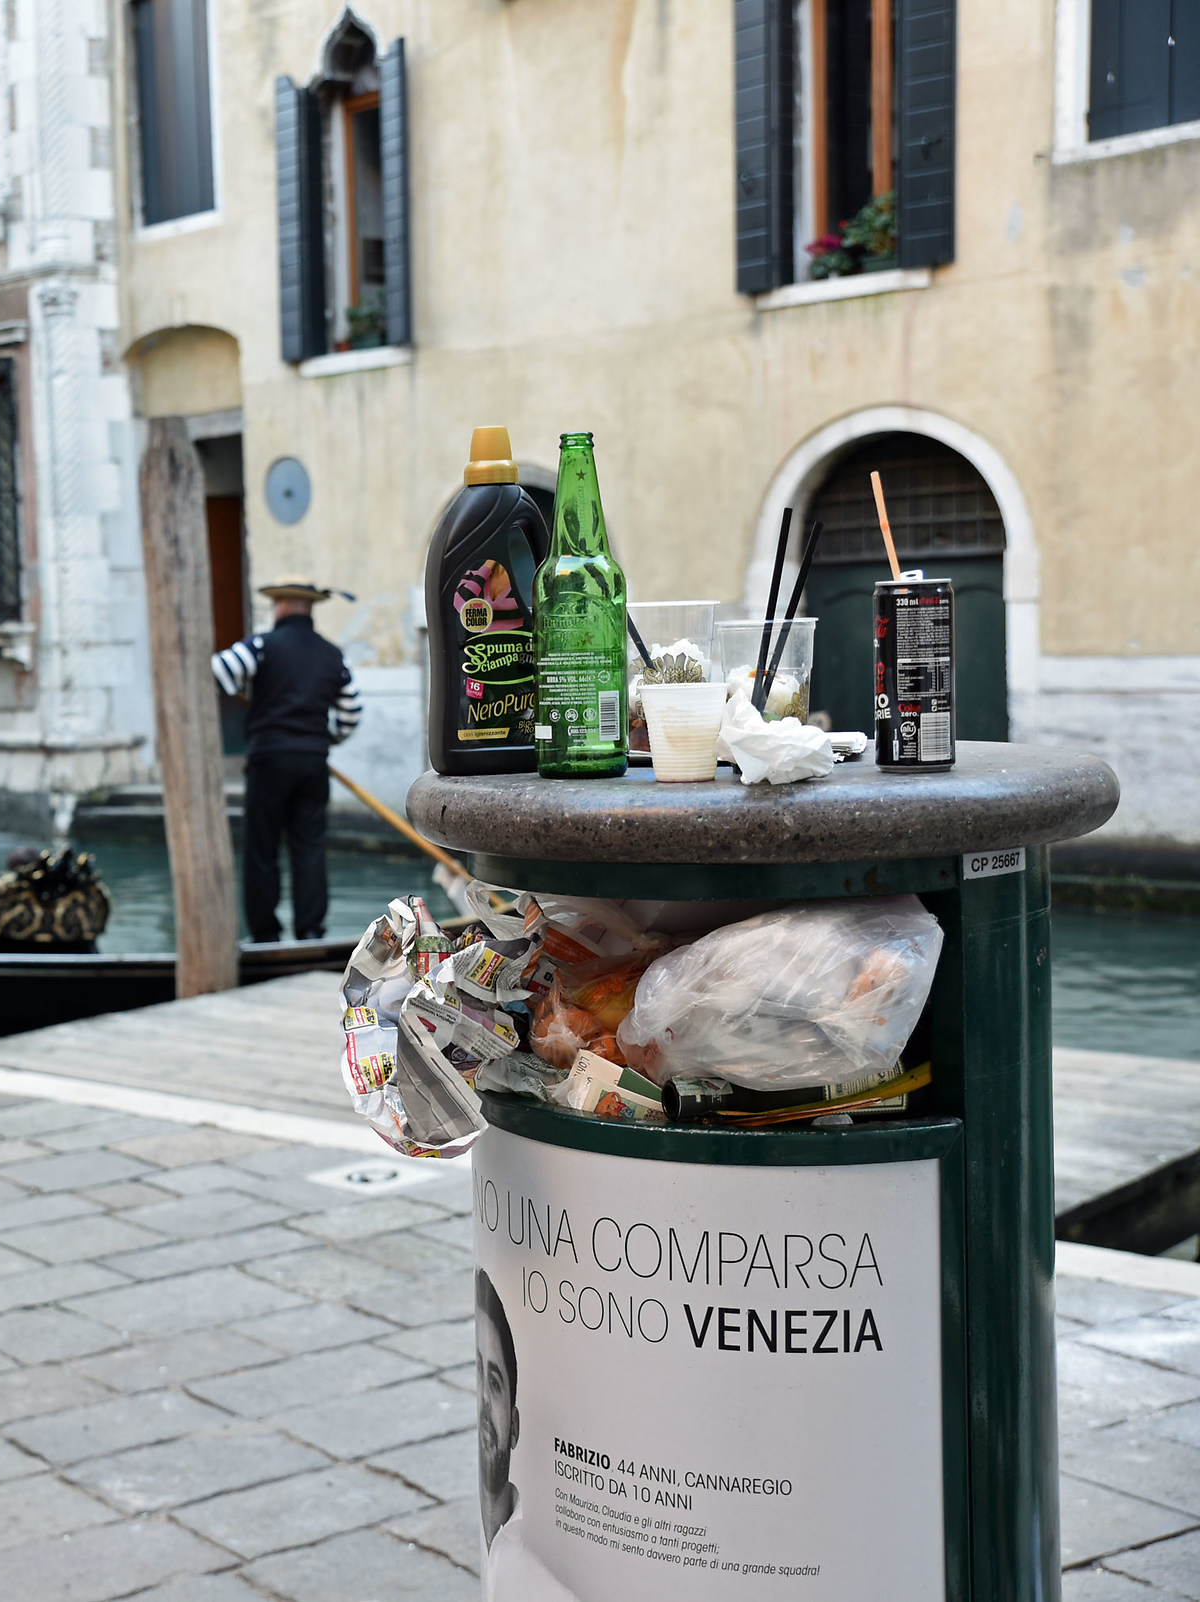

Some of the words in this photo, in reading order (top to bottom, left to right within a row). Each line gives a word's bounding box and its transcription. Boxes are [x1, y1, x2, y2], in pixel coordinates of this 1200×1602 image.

[466, 608, 488, 618] FERMA
[466, 617, 488, 627] COLOR
[461, 652, 535, 674] Sciampagn
[464, 643, 523, 665] Spuma
[470, 681, 480, 691] 16
[971, 857, 989, 872] CP
[991, 851, 1020, 870] 25667
[507, 1190, 578, 1264] UNA
[592, 1217, 883, 1290] COMPARSA
[523, 1266, 549, 1314] IO
[559, 1280, 669, 1343] SONO
[683, 1303, 884, 1354] VENEZIA
[554, 1459, 605, 1491] ISCRITTO
[608, 1478, 628, 1498] DA
[632, 1484, 651, 1503] 10
[654, 1490, 692, 1511] ANNI
[617, 1459, 635, 1477] 44
[639, 1464, 681, 1487] ANNI,
[684, 1471, 793, 1496] CANNAREGIO
[554, 1487, 568, 1501] Con
[601, 1504, 632, 1524] Claudia
[633, 1515, 640, 1525] e
[641, 1516, 653, 1530] gli
[654, 1519, 673, 1532] altri
[673, 1523, 707, 1537] ragazzi
[555, 1503, 586, 1523] collaboro
[586, 1516, 601, 1529] con
[602, 1521, 649, 1543] entusiasmo
[650, 1534, 658, 1544] a
[659, 1534, 680, 1549] tanti
[681, 1539, 720, 1555] progetti;
[555, 1516, 562, 1528] in
[562, 1520, 586, 1538] questo
[586, 1530, 608, 1547] modo
[609, 1539, 620, 1550] mi
[621, 1541, 645, 1557] sento
[646, 1547, 681, 1564] davvero
[683, 1554, 708, 1567] parte
[709, 1558, 719, 1569] di
[721, 1560, 740, 1572] una
[741, 1562, 776, 1575] grande
[778, 1563, 821, 1578] squadra!
